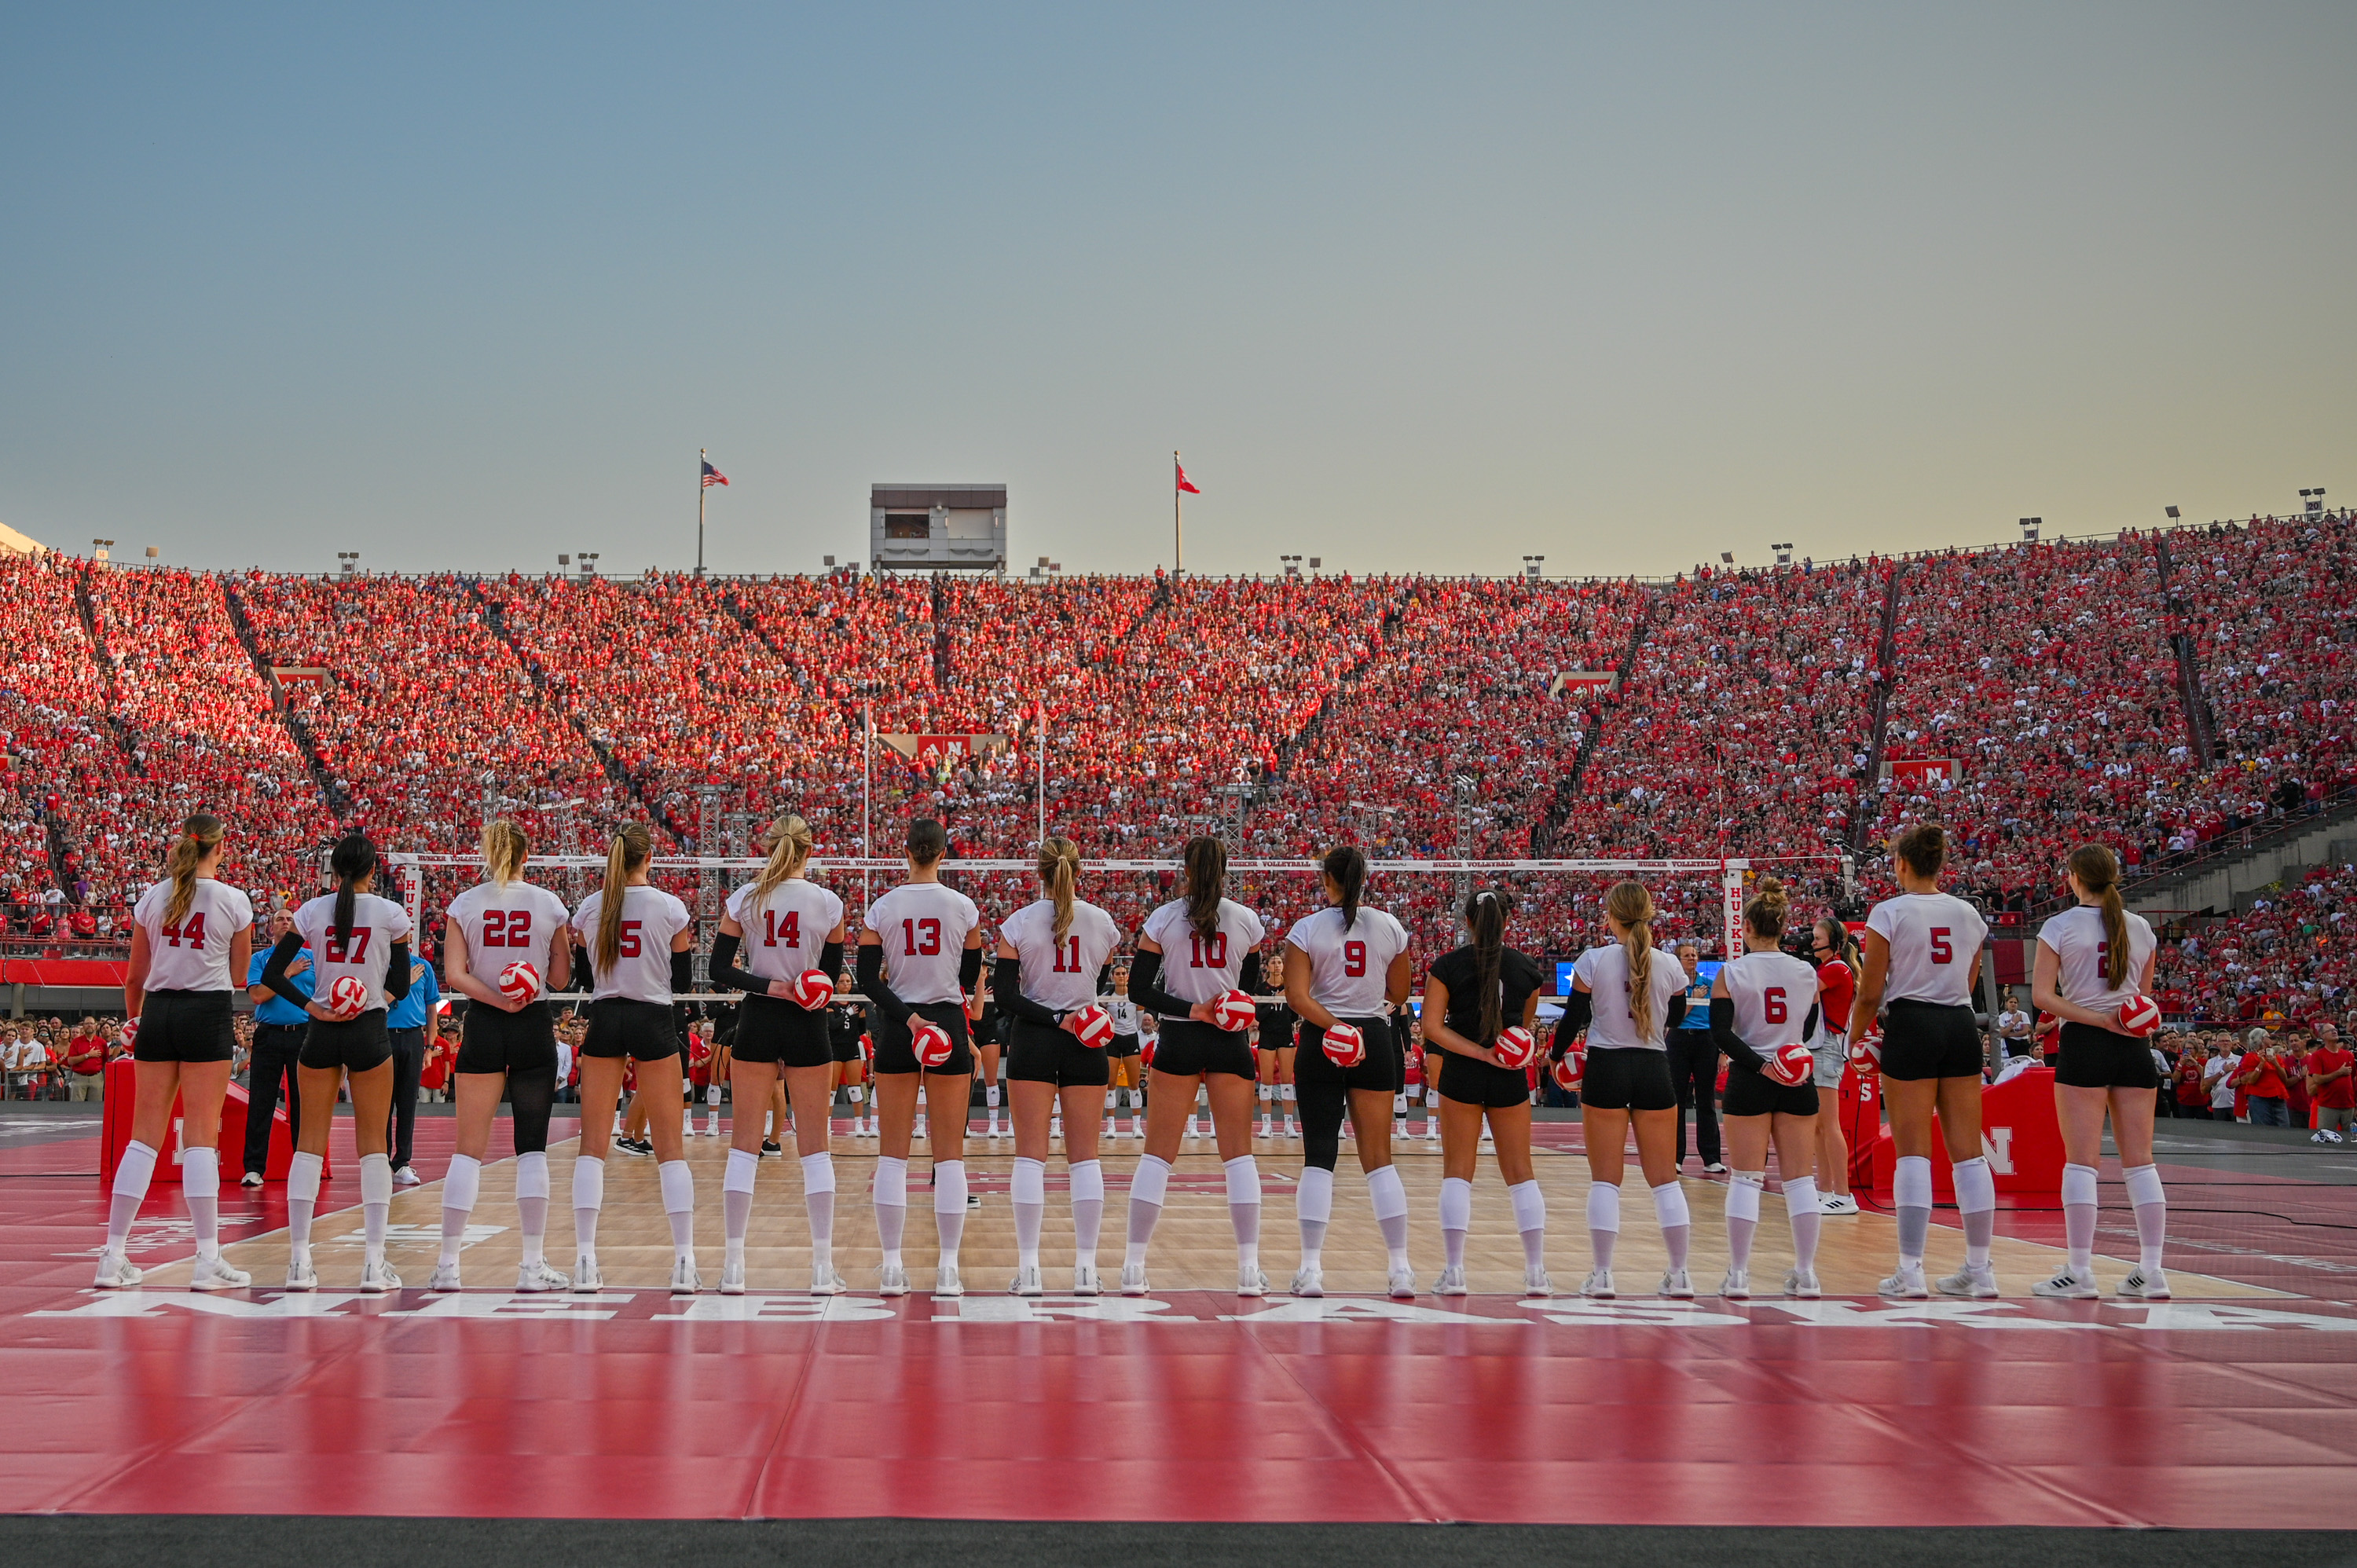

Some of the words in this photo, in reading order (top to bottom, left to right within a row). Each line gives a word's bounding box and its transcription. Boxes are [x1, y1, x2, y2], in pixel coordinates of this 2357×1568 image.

[948, 742, 962, 756] N
[1926, 768, 1942, 783] N
[162, 912, 205, 950] 44
[325, 925, 372, 964] 27
[483, 909, 531, 947] 22
[763, 910, 800, 948] 14
[903, 918, 940, 955] 13
[1930, 926, 1952, 964] 5
[1053, 935, 1081, 973] 11
[1189, 929, 1227, 969] 10
[1344, 940, 1366, 977] 9
[844, 1018, 850, 1029] 5
[1117, 1009, 1127, 1020] 14
[1764, 987, 1787, 1024] 6
[22, 1288, 2357, 1331] NEBRASKA
